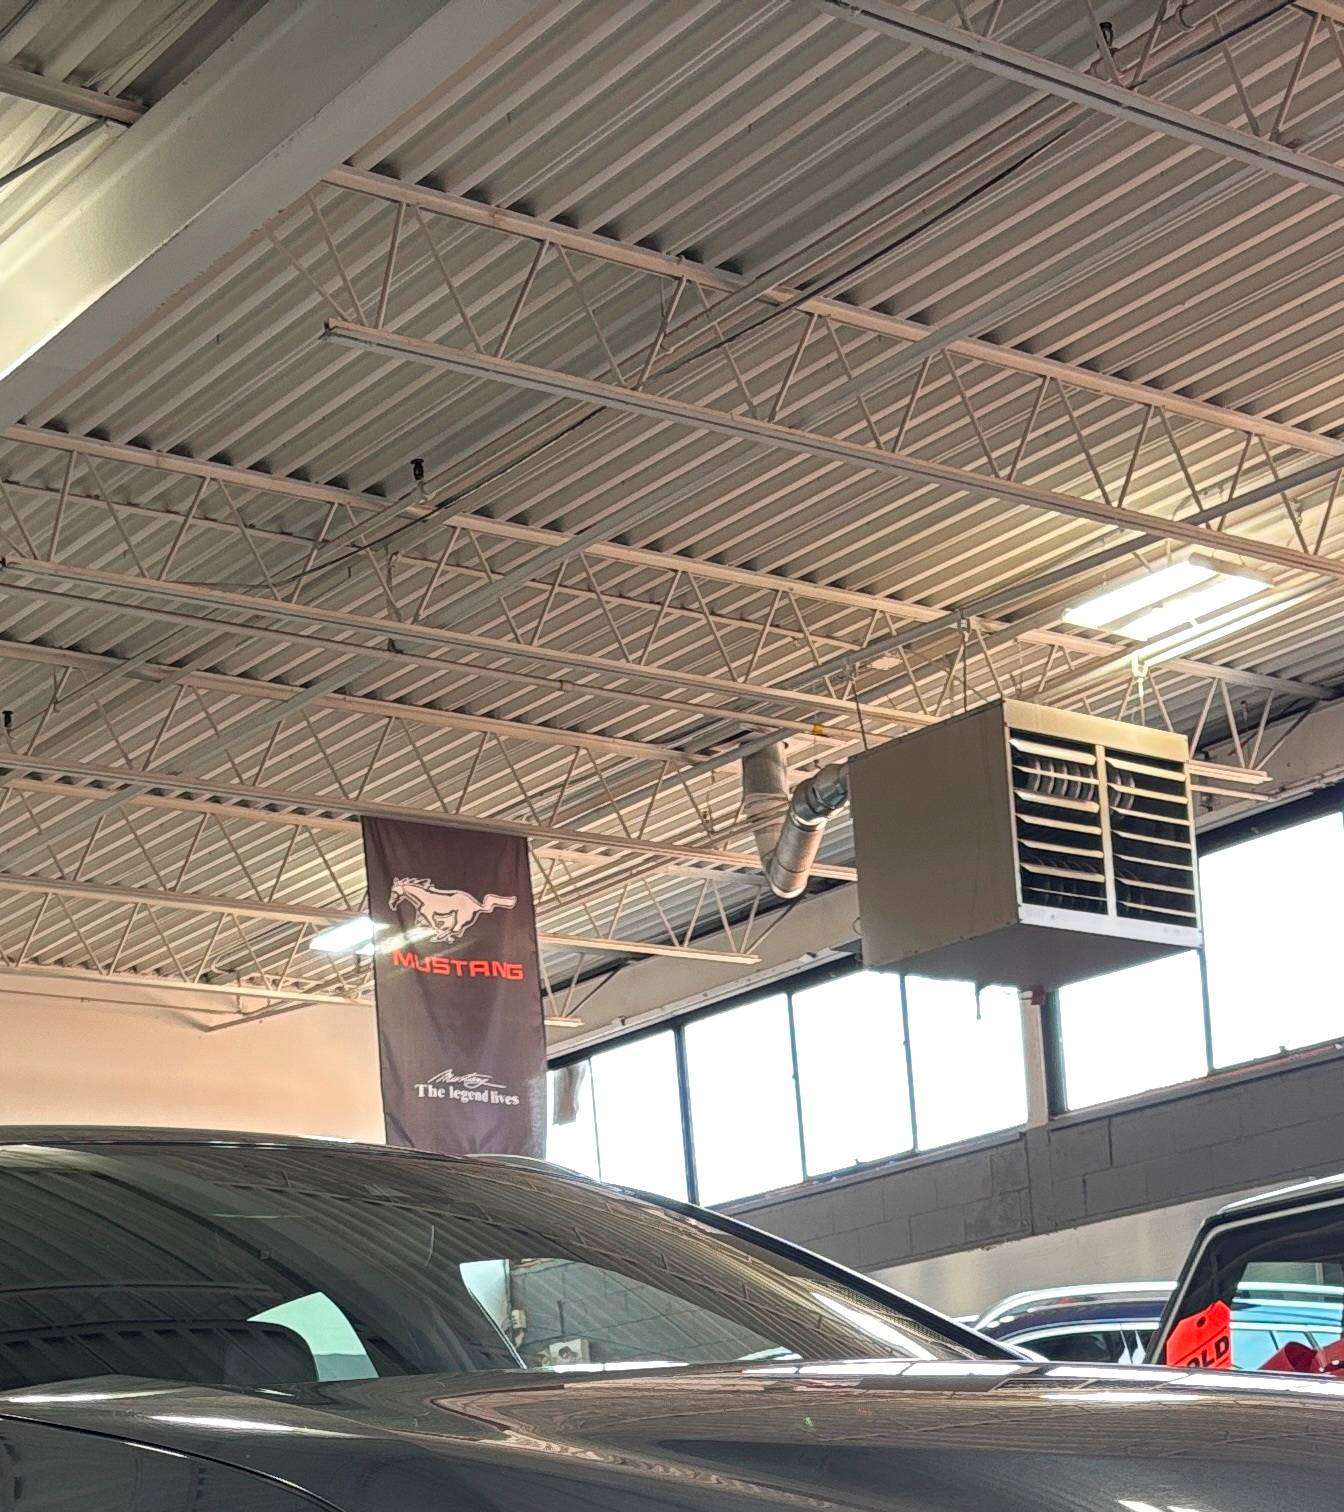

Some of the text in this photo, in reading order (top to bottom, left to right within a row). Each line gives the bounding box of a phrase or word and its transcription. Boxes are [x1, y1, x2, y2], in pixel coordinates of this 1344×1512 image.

[392, 949, 524, 981] MUSTANG
[414, 1083, 520, 1105] The legend lives
[1187, 1335, 1230, 1368] OLD
